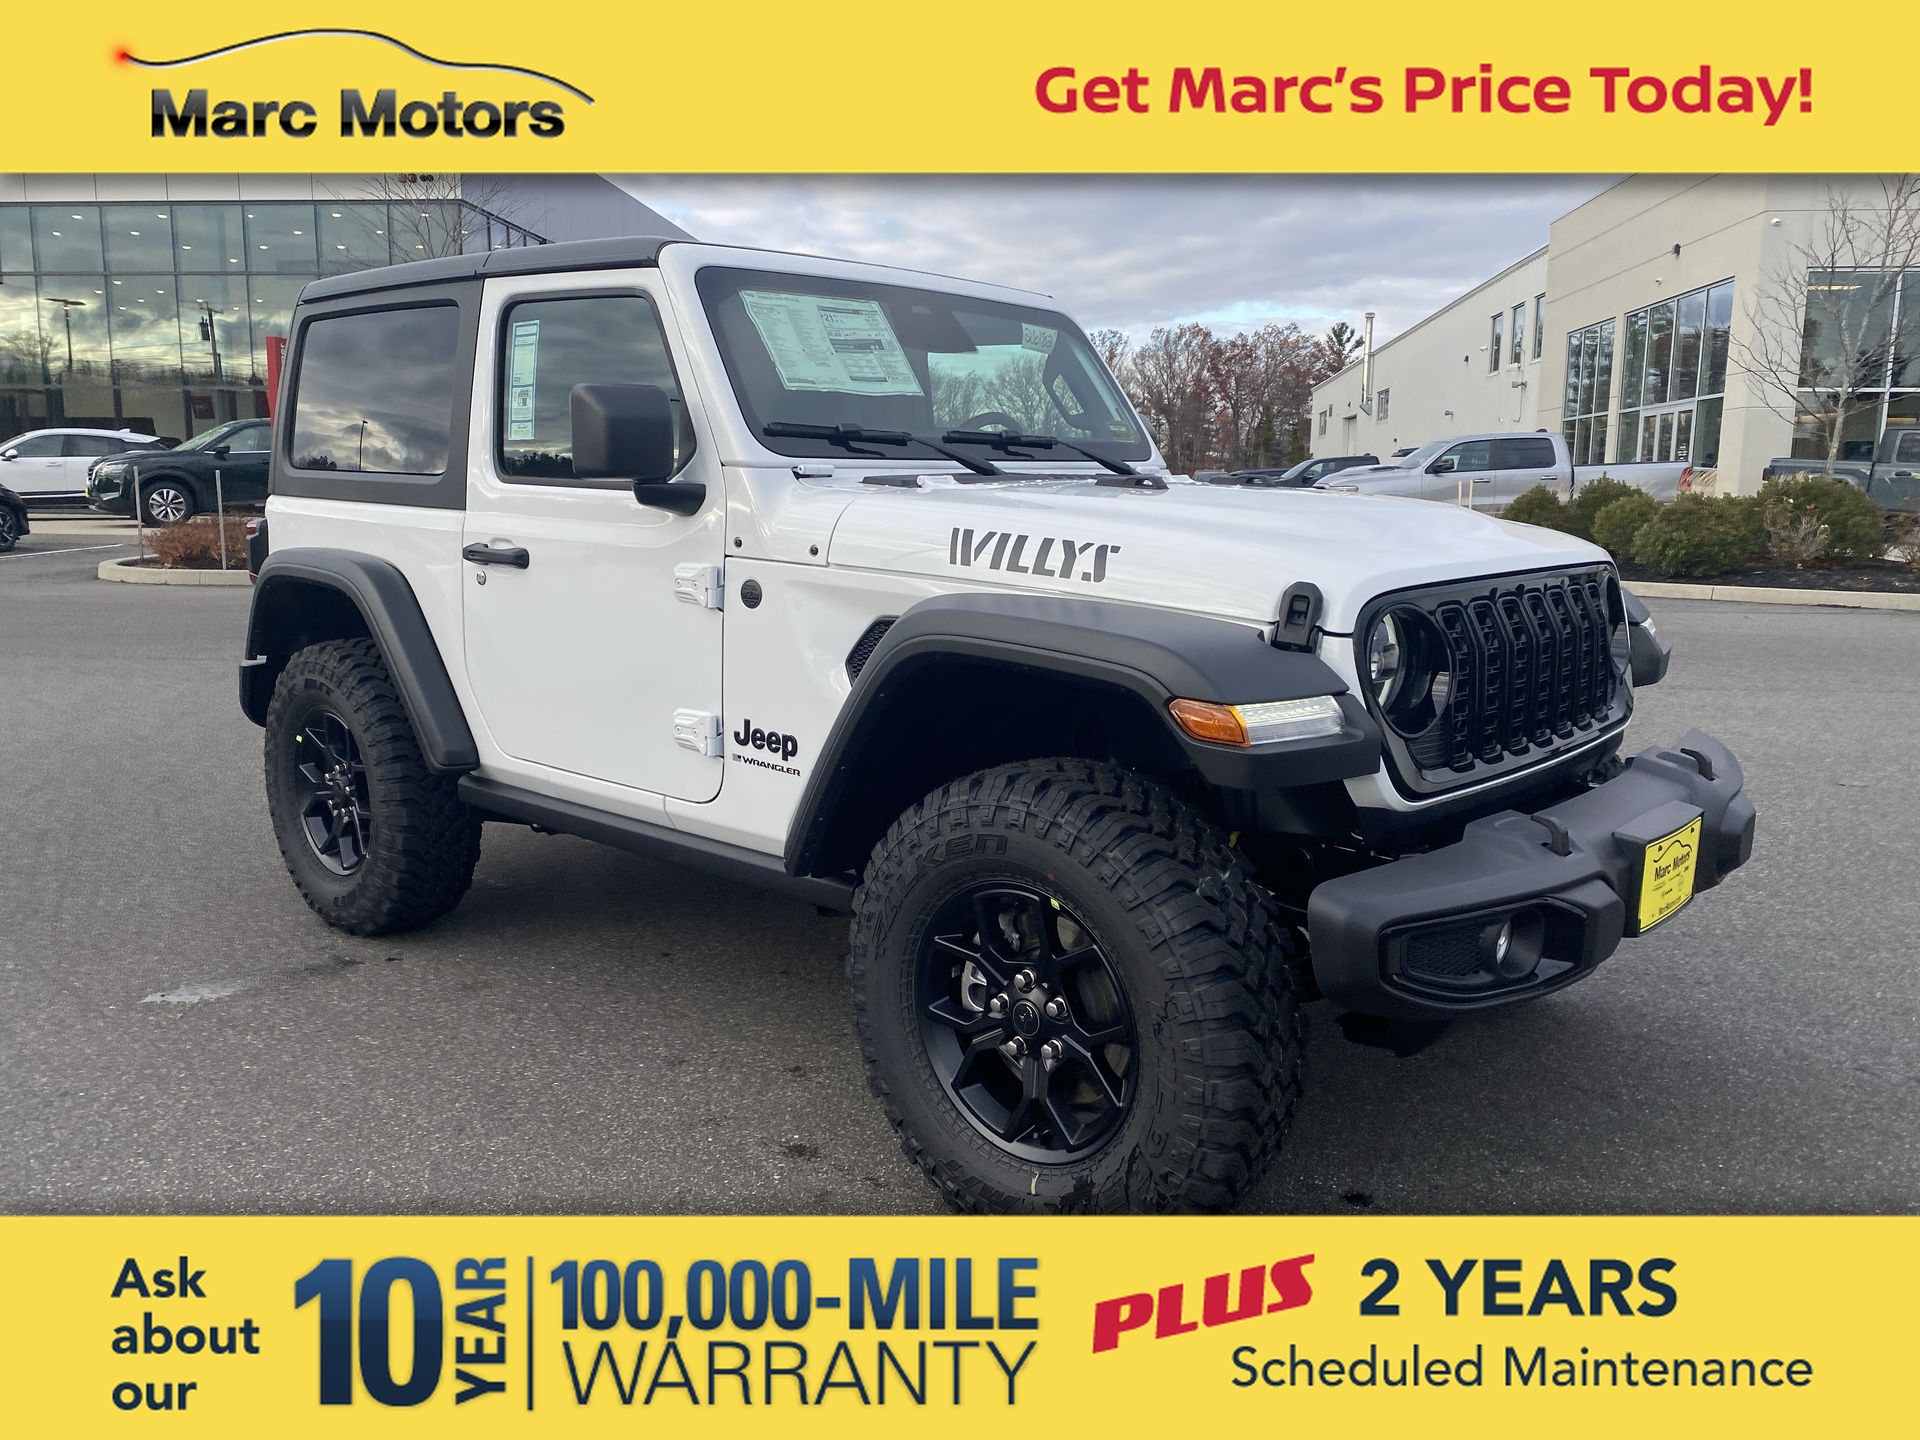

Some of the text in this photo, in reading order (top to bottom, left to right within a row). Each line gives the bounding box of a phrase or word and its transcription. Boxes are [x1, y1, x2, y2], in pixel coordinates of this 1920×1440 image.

[949, 527, 1122, 583] WILLYS
[733, 718, 798, 762] Jeep
[741, 755, 801, 777] WRANGLER
[1654, 864, 1671, 881] Marc
